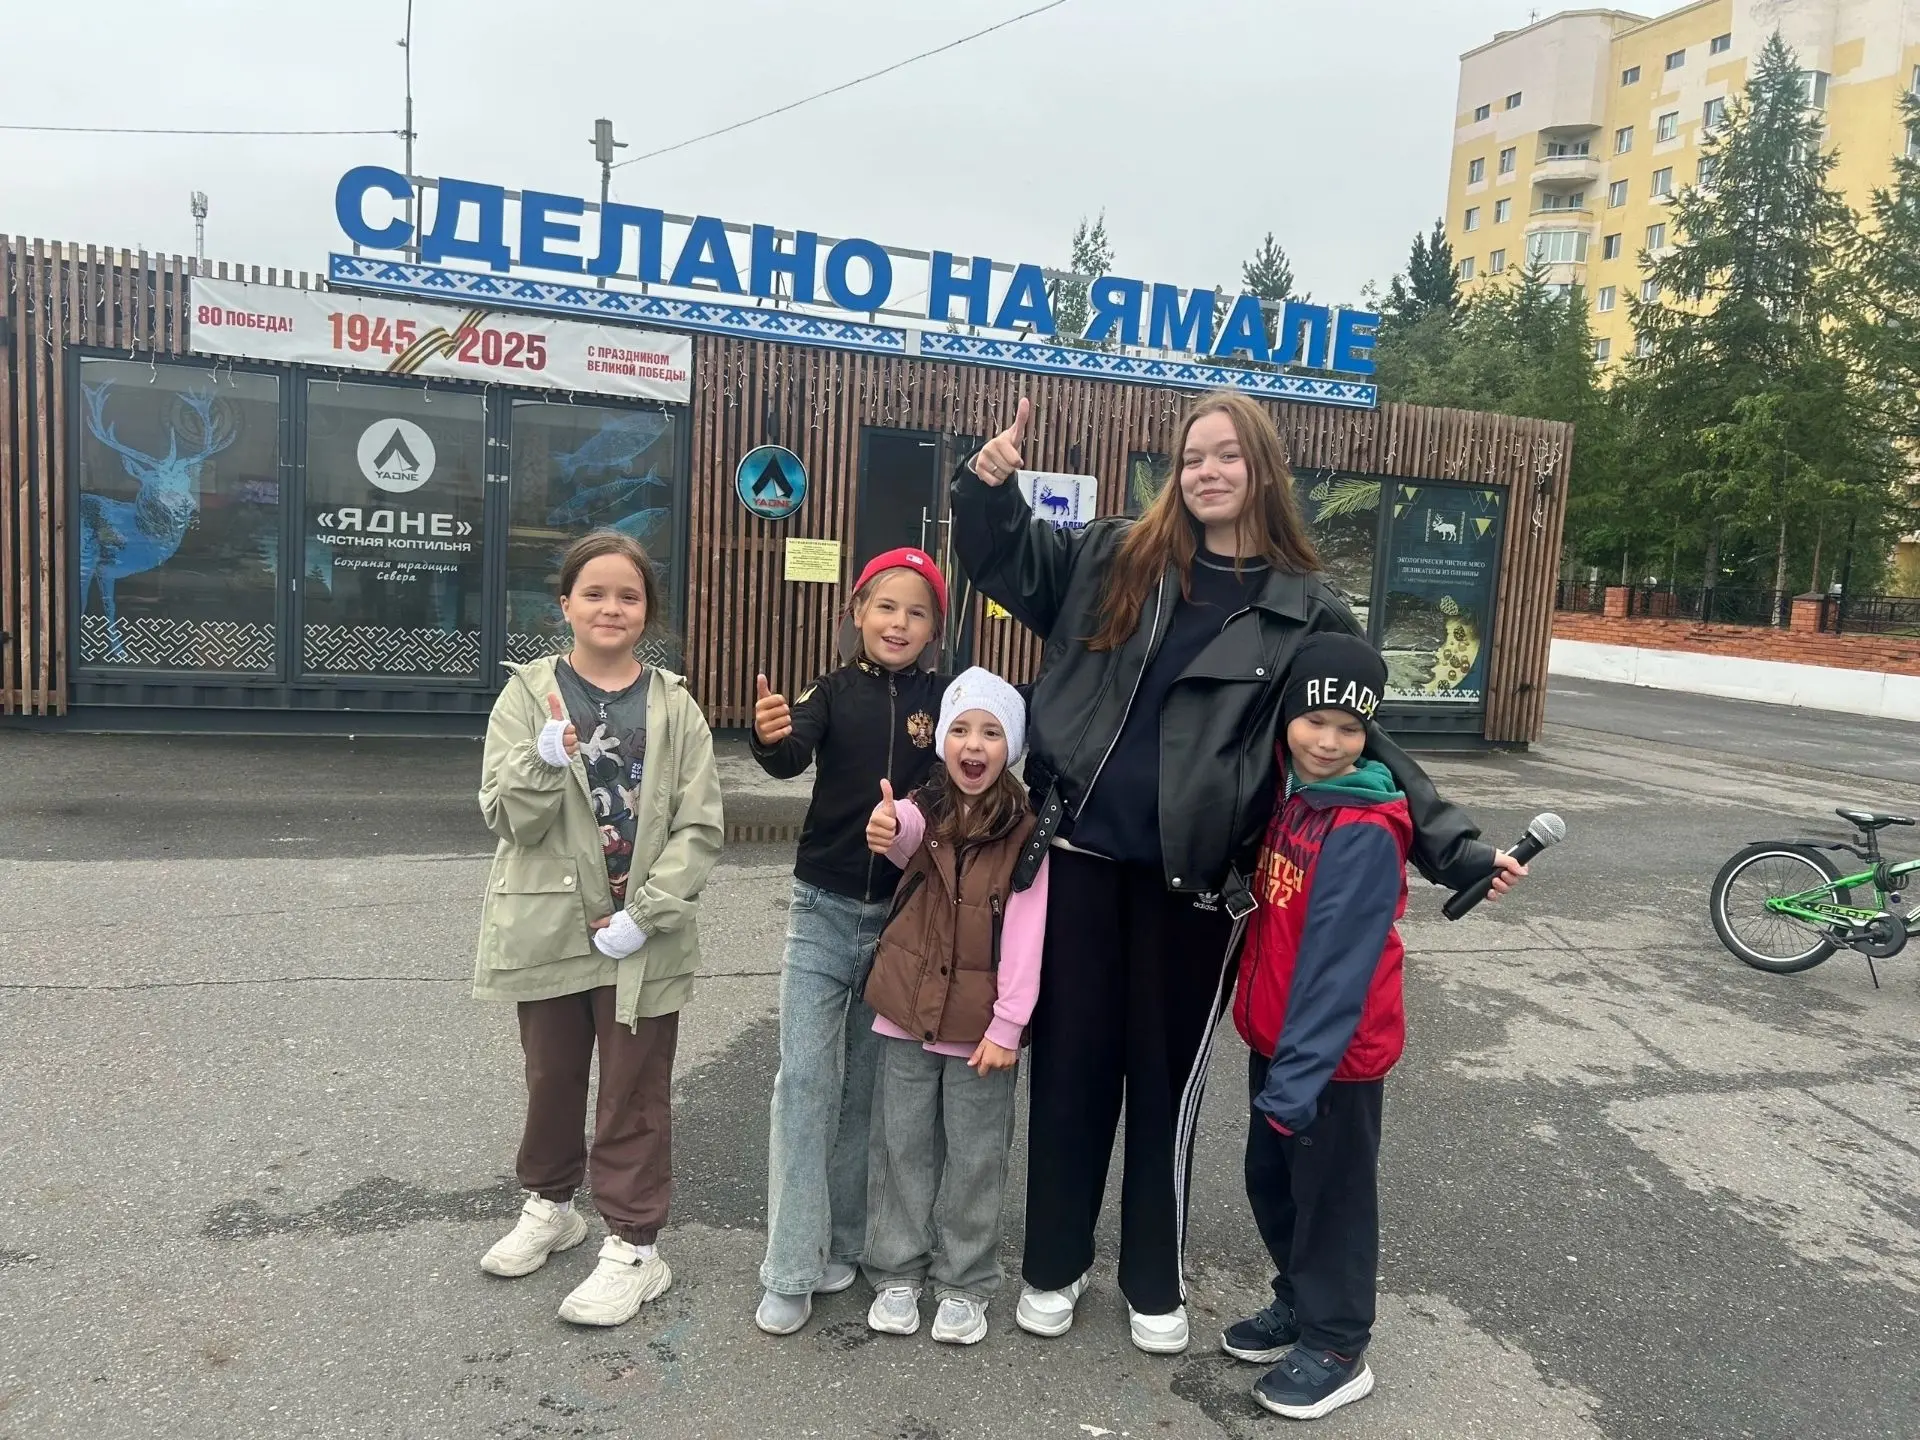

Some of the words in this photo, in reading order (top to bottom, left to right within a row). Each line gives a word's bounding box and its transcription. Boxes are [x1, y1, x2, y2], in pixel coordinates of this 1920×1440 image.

[335, 165, 893, 312] СДЕЛАНО
[926, 250, 1058, 336] НА
[1081, 275, 1381, 375] ЯМАЛЕ
[198, 305, 223, 327] 80
[226, 310, 293, 332] ПОБЕДА!
[328, 311, 417, 356] 1945
[457, 327, 547, 371] 2025
[587, 345, 596, 357] С
[598, 347, 670, 366] ПРАЗДНИКОМ
[587, 360, 636, 377] ВЕЛИКОЙ
[638, 366, 686, 382] ПОБЕДЫ!
[317, 507, 473, 537] «ЯДНЕ»
[316, 534, 383, 547] ЧАСТНАЯ
[388, 538, 471, 552] КОПТИЛЬНЯ
[334, 557, 391, 569] Сохраняя
[397, 560, 458, 574] традиции
[376, 571, 417, 584] Севера
[1307, 677, 1379, 720] READY
[1193, 901, 1218, 912] adidas
[1819, 904, 1873, 920] PILOT
